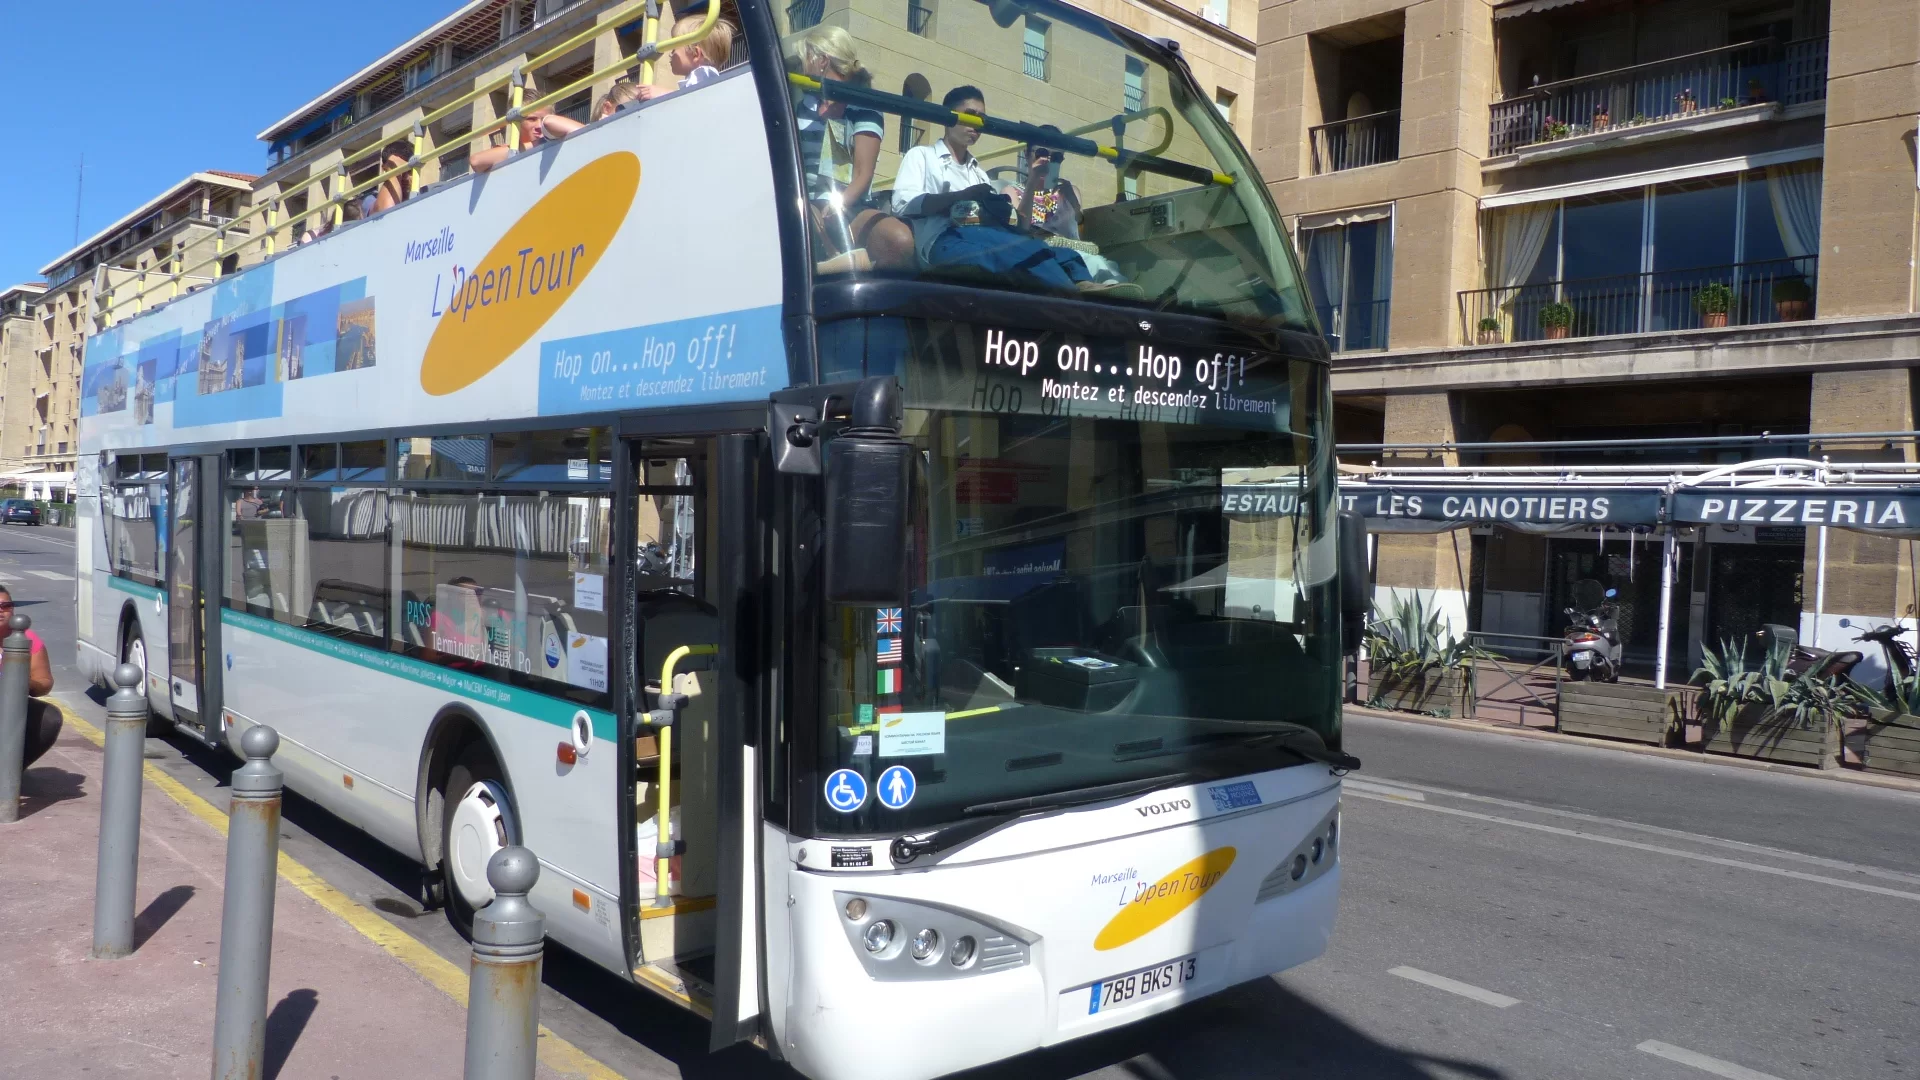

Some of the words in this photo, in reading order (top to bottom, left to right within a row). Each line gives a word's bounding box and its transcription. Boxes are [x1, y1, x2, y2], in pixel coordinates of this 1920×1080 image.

[404, 226, 455, 264] Marseille
[554, 350, 582, 384] Hop
[687, 324, 737, 370] off!
[985, 329, 1039, 375] Hop
[1195, 353, 1245, 391] off!
[580, 384, 613, 401] Montez
[618, 383, 631, 399] et
[636, 374, 694, 397] descendez
[701, 367, 767, 392] librement
[1042, 379, 1099, 401] Montez
[1108, 385, 1125, 403] et
[1134, 386, 1208, 409] descendez
[1214, 392, 1277, 414] librement
[1376, 495, 1423, 516] LES
[1442, 496, 1610, 520] CANOTIERS
[1700, 499, 1906, 524] PIZZERIA
[407, 600, 432, 628] PASS
[1135, 799, 1192, 817] VOLVO
[1091, 867, 1138, 887] Marseille
[1103, 976, 1136, 1007] 789
[1140, 965, 1173, 995] BKS
[1178, 958, 1197, 983] 13
